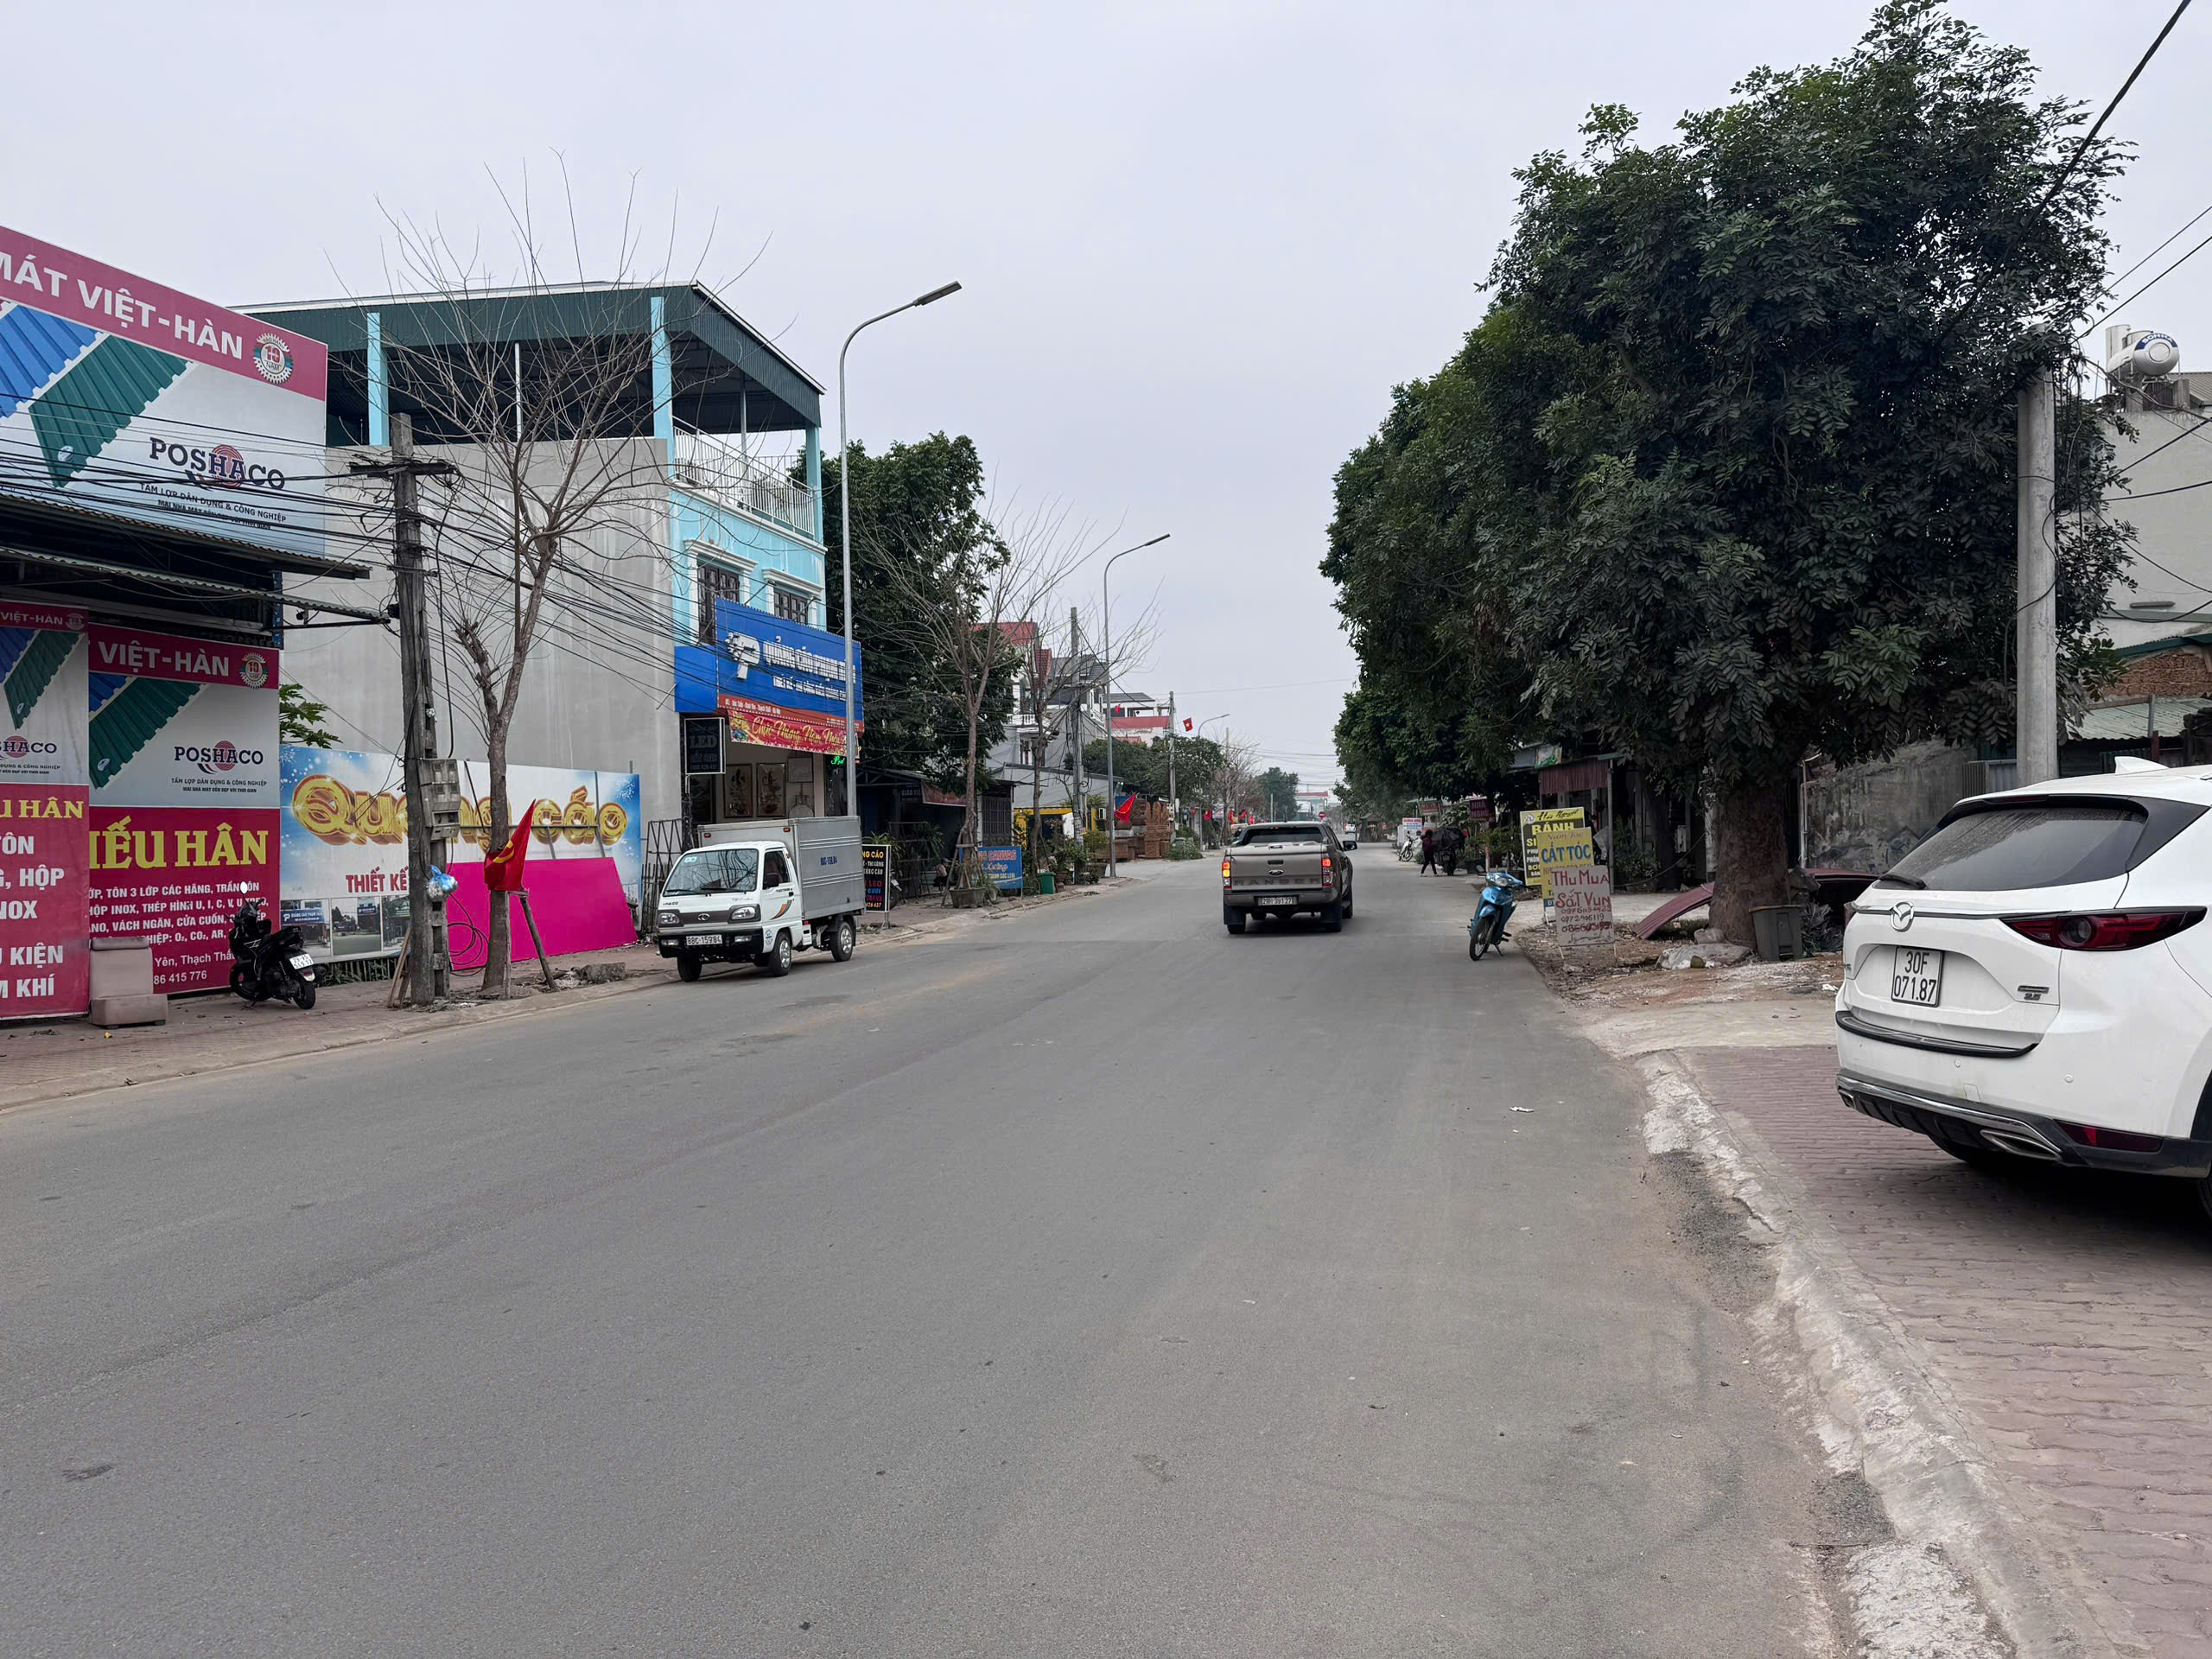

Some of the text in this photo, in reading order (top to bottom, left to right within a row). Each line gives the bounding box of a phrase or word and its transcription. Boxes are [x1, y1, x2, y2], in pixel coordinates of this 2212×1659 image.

[77, 278, 243, 360] VIỆT-HÀN
[149, 436, 285, 490] POSHACO
[234, 502, 256, 516] CÔNG
[257, 507, 287, 523] NGHIỆP
[1, 611, 63, 626] VIỆT-HÀN
[99, 640, 229, 677] VIỆT-HÀN
[0, 741, 57, 753] HACO
[174, 746, 264, 766] POSHACO
[18, 796, 84, 818] HÂN
[0, 831, 35, 855] ÔN
[175, 823, 269, 867] HÂN
[19, 864, 65, 890] HỘP
[346, 865, 410, 893] THIẾT KẾ
[106, 886, 128, 899] TÔN
[130, 887, 137, 897] 3
[139, 885, 159, 897] LỚP
[162, 884, 182, 896] CÁC
[184, 882, 213, 895] HÃNG,
[245, 880, 259, 892] ÔN
[111, 904, 139, 915] INOX,
[142, 901, 167, 913] THÉP
[169, 899, 194, 912] HÌNH
[195, 900, 206, 910] U,
[207, 899, 214, 910] I,
[216, 899, 226, 909] C,
[236, 899, 243, 907] U
[89, 922, 110, 933] NO,
[112, 919, 140, 931] VÁCH
[143, 917, 174, 929] NGĂN,
[176, 914, 196, 927] CỬA
[199, 912, 227, 925] CUỐN,
[211, 930, 226, 939] AR,
[10, 942, 63, 968] KIỆN
[155, 957, 178, 968] Yên,
[180, 953, 212, 966] Thạch
[1904, 950, 1929, 976] 30F
[16, 973, 55, 998] KHÍ
[154, 970, 207, 985] 86 415 776
[1893, 976, 1937, 1003] 071.87
